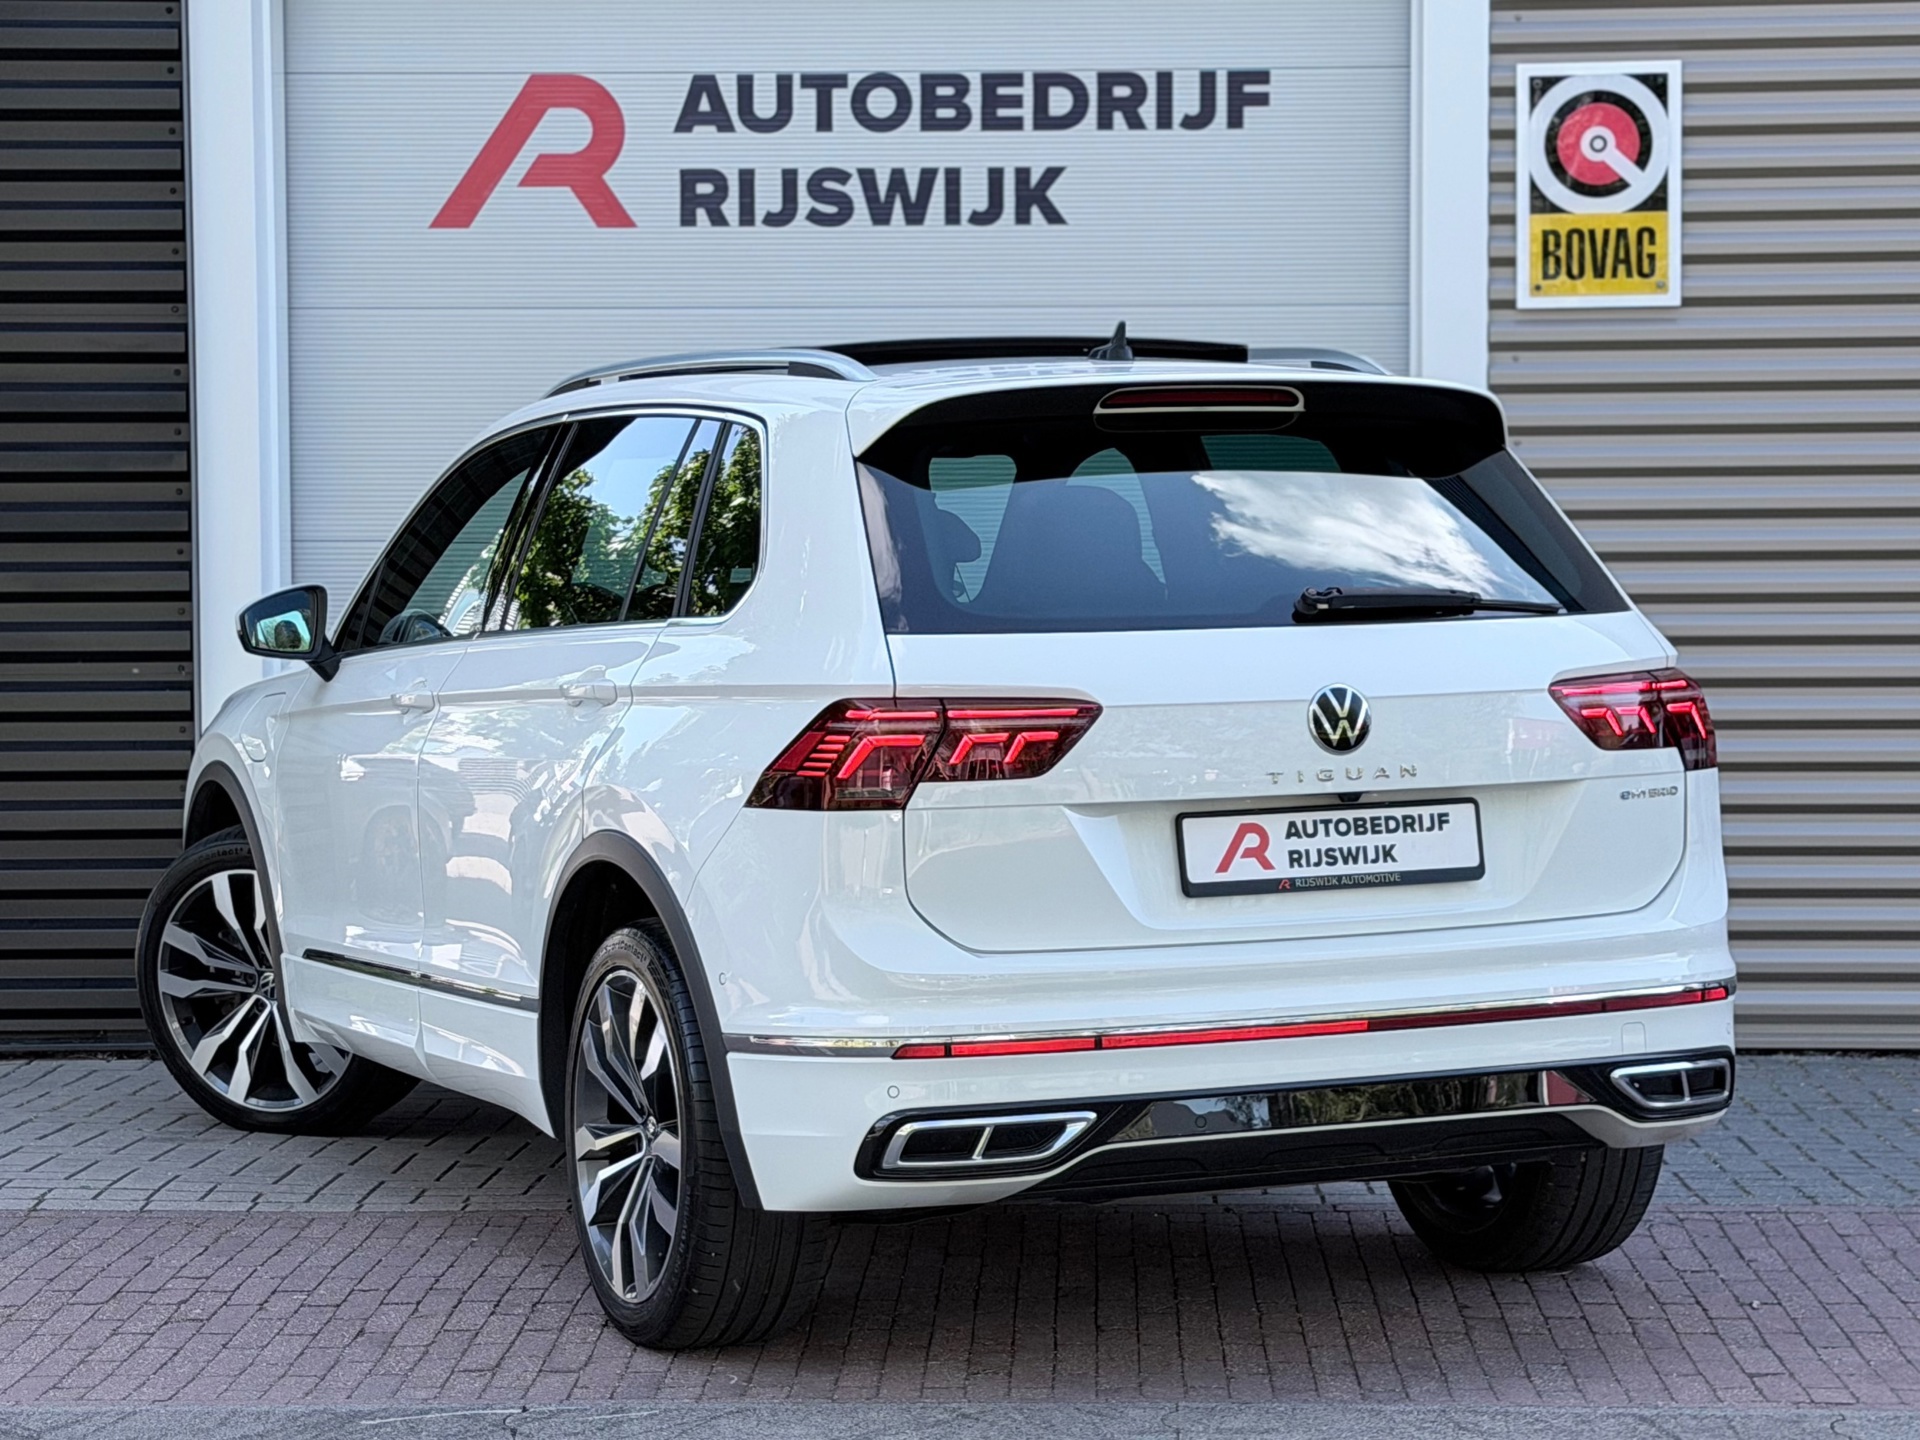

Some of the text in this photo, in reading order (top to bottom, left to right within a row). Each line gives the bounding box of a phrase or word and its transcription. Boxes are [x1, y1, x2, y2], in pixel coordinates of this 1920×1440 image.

[673, 69, 1271, 134] AUTOBEDRIJF
[679, 166, 1068, 228] RIJSWIJK
[1541, 226, 1657, 281] BOVAG
[1265, 764, 1417, 785] TIGUAN
[1285, 812, 1450, 840] AUTOBEDRIJF
[1288, 844, 1398, 869] RIJSWIJK
[1295, 876, 1339, 888] RIJSWIJK
[1341, 872, 1401, 885] AUTOMOTIVE
